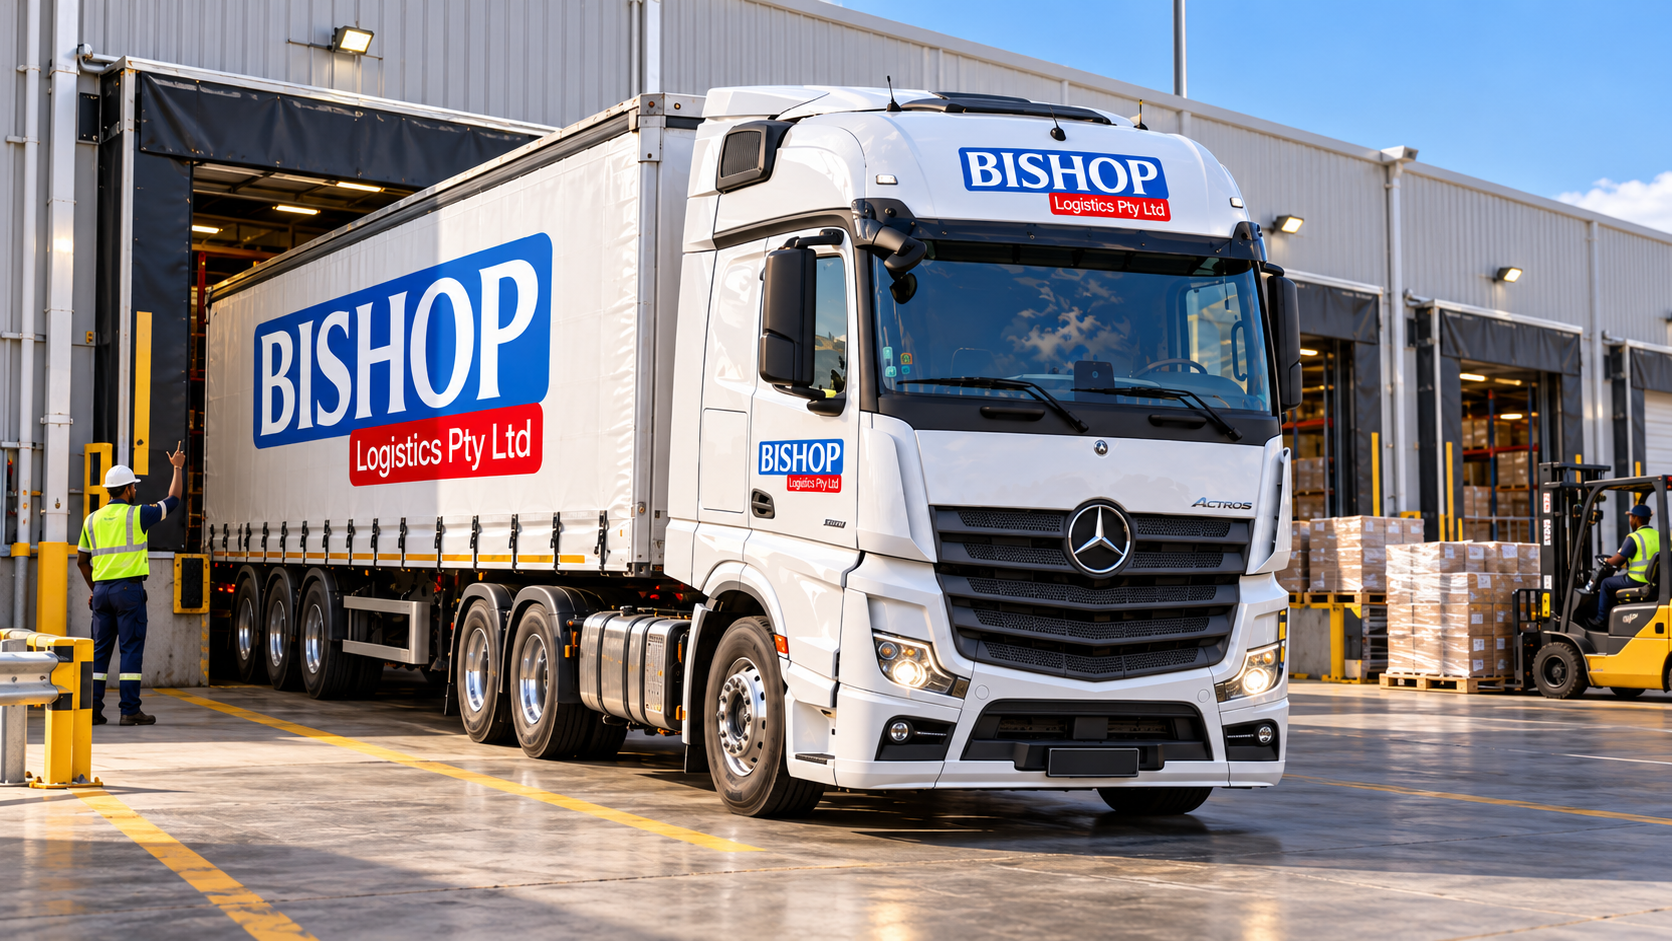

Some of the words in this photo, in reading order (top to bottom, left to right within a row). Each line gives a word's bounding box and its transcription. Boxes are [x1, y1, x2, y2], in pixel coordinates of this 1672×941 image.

[966, 152, 1158, 195] BISHOP
[1054, 196, 1115, 214] Logistics
[1118, 200, 1139, 217] Pty
[1143, 202, 1165, 217] Ltd
[260, 259, 539, 436] BISHOP
[357, 433, 442, 478] Logistics
[448, 427, 485, 471] Pty
[492, 419, 531, 460] Ltd
[761, 443, 841, 472] BISHOP
